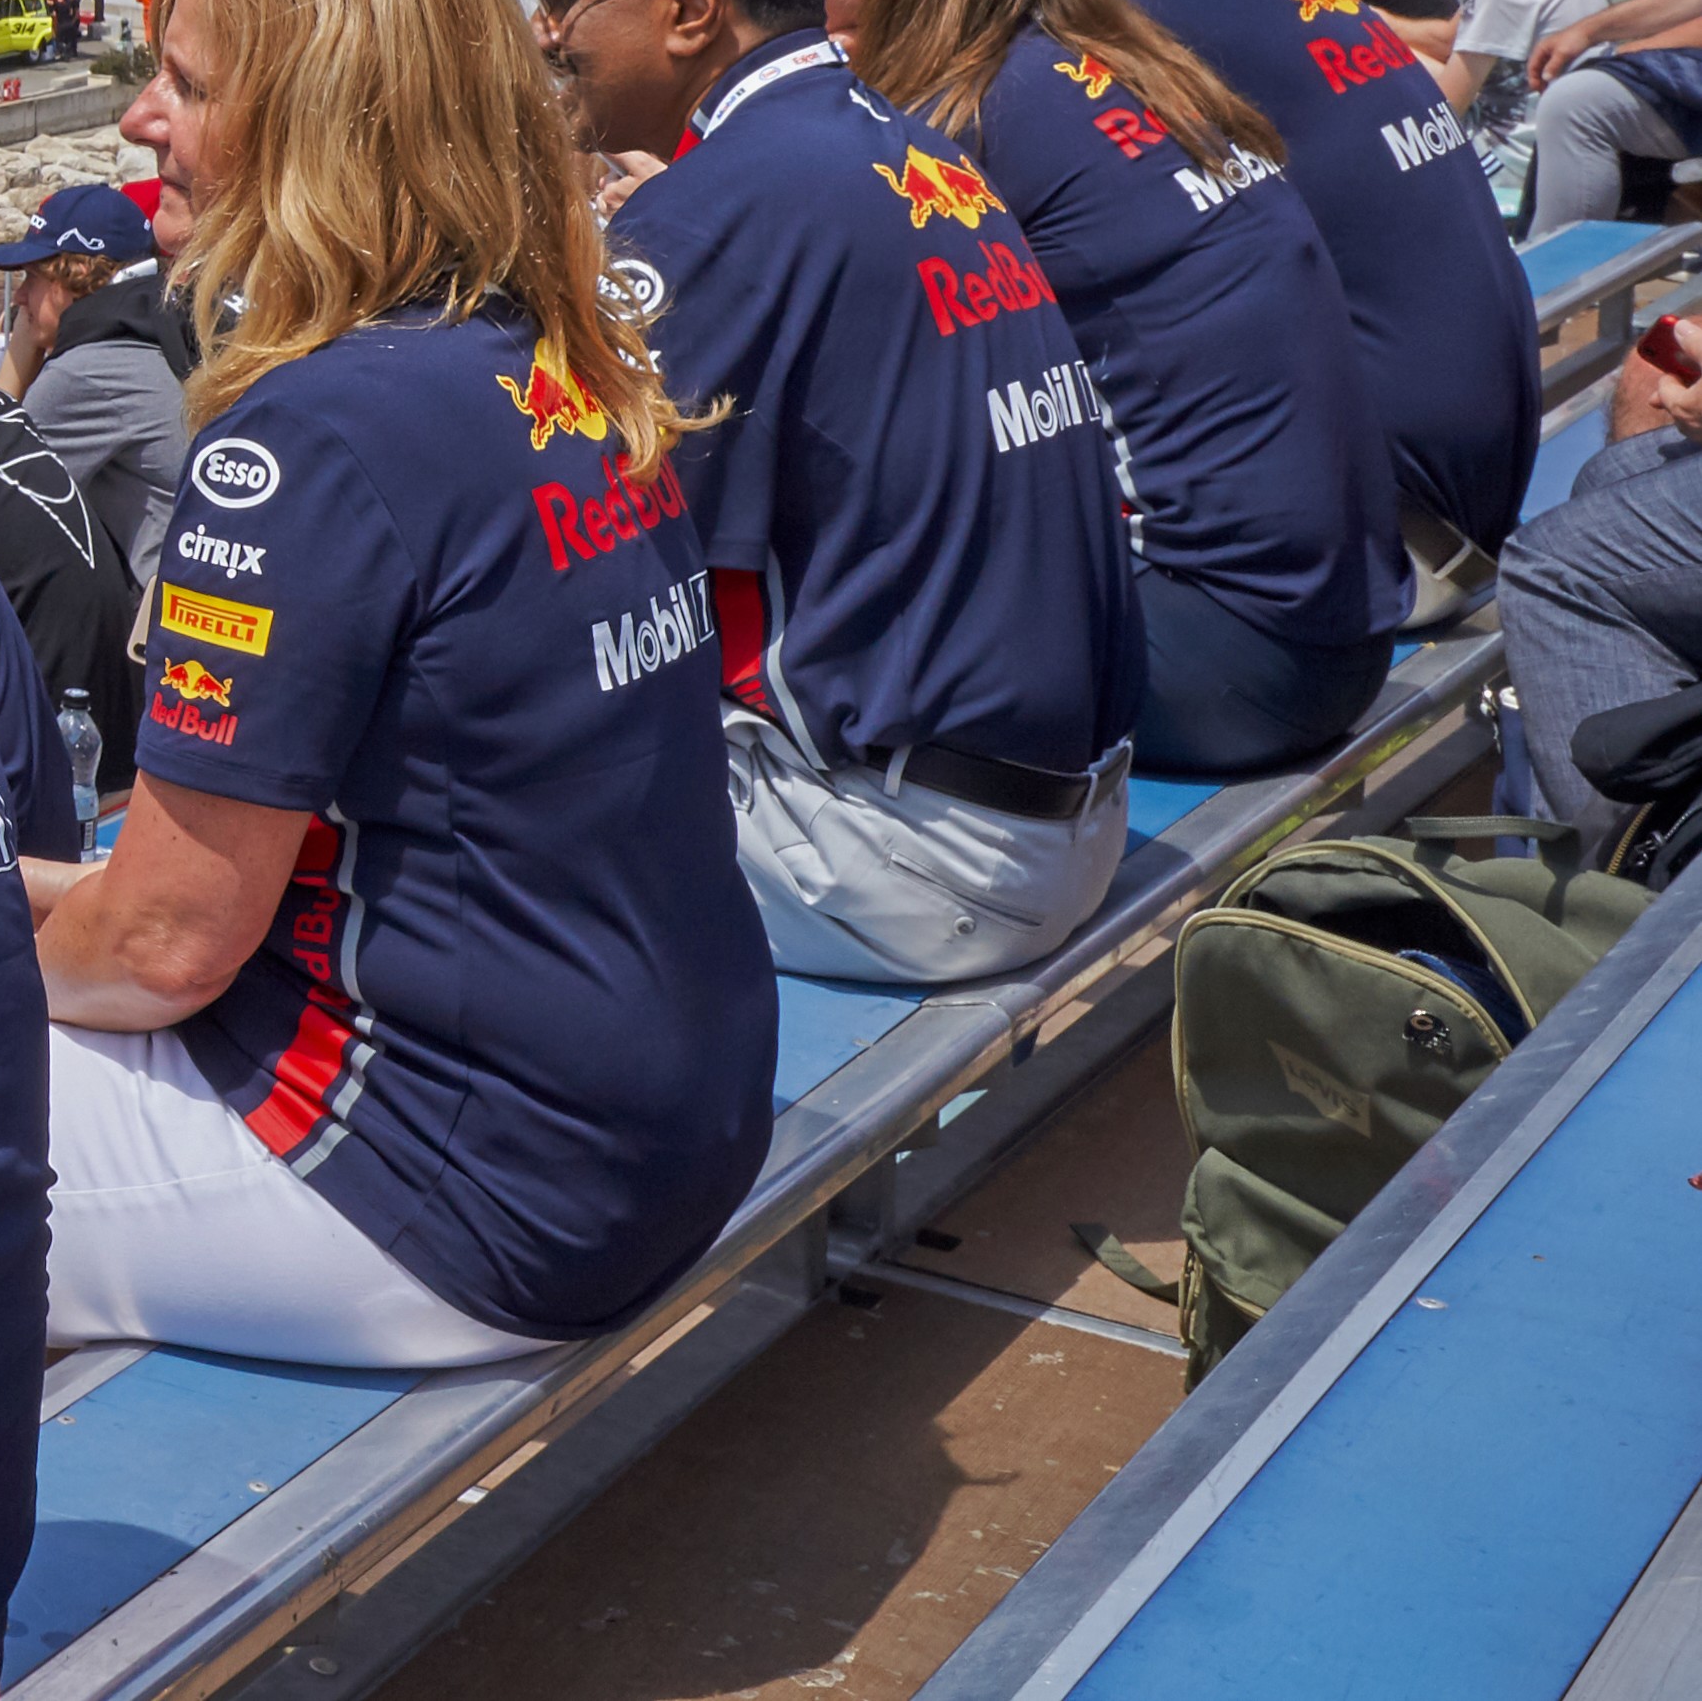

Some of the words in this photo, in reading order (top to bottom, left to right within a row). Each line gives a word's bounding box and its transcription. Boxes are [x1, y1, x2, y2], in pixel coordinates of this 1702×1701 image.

[11, 22, 36, 35] 314
[916, 239, 1020, 337] Red
[532, 455, 639, 571] Red
[169, 594, 259, 643] PIRELLI
[592, 582, 697, 692] Mobil
[150, 691, 184, 730] Red
[179, 704, 239, 747] Bull
